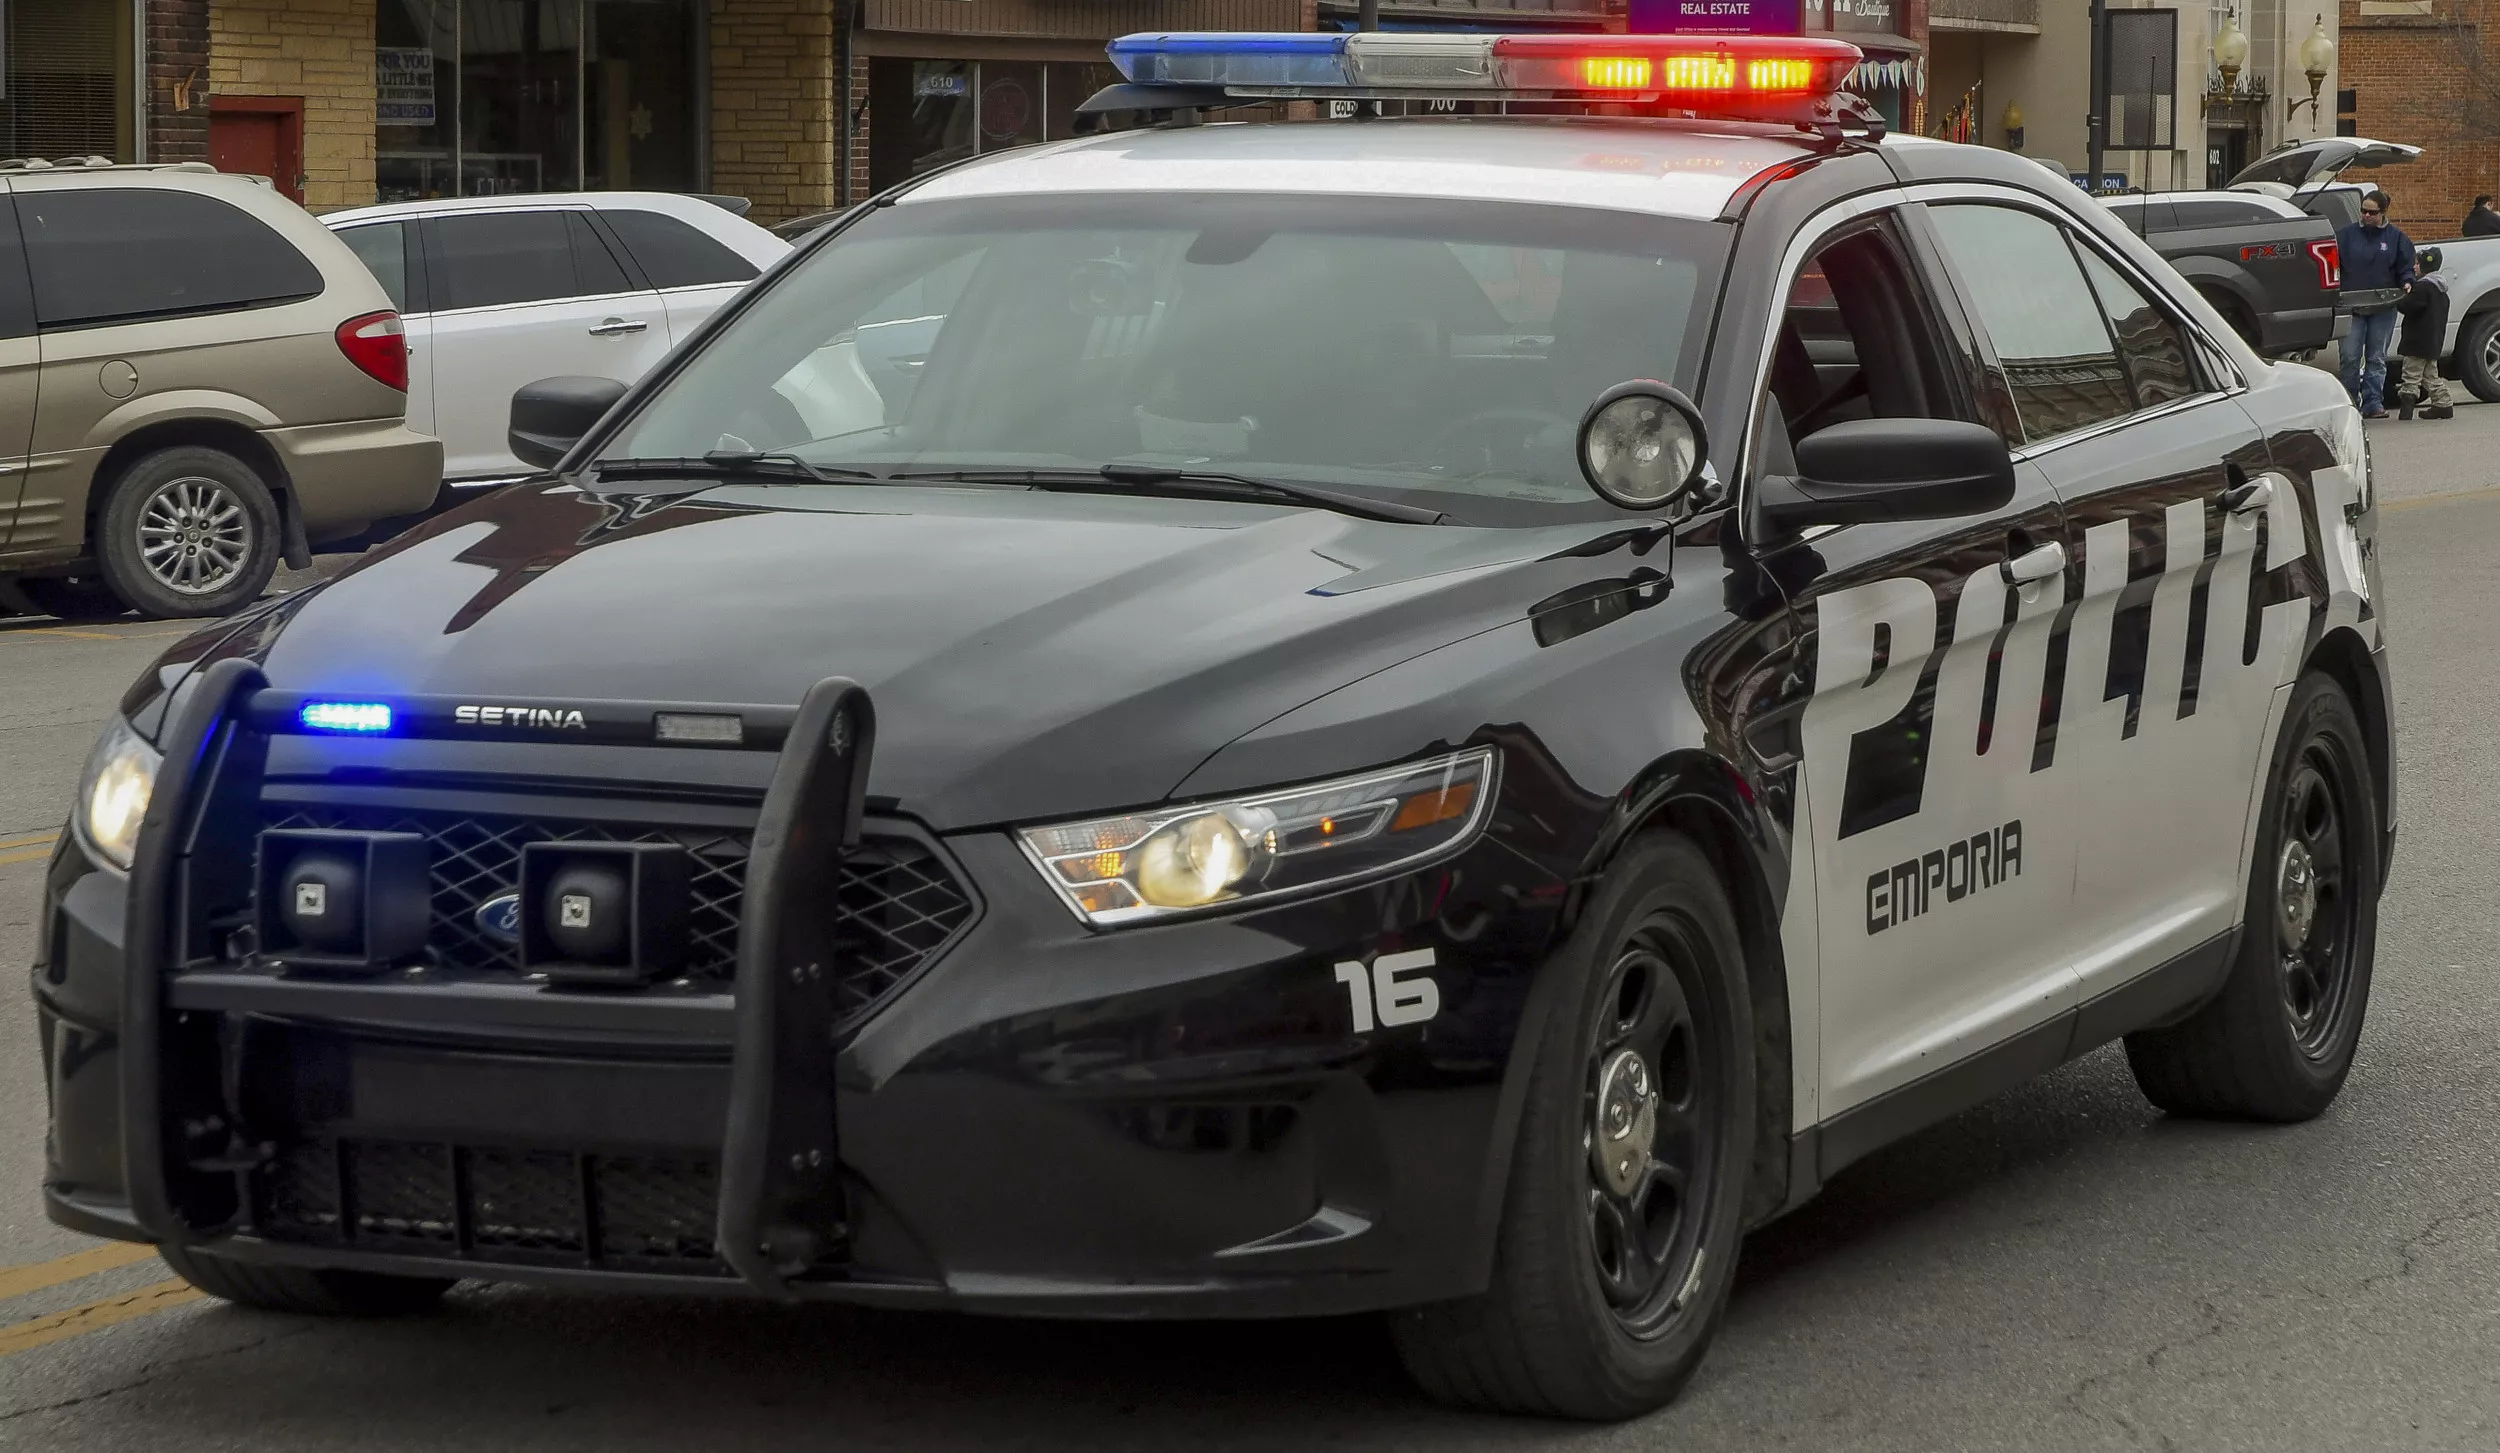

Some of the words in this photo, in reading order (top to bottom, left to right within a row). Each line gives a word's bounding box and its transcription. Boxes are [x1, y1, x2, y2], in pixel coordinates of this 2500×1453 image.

[1680, 3, 1707, 15] REAL
[1710, 3, 1750, 15] ESTATE
[403, 54, 430, 69] YOU
[931, 76, 953, 88] 610
[402, 106, 429, 117] USED
[1335, 101, 1355, 116] COLD
[2209, 150, 2220, 165] 602
[2073, 178, 2120, 189] CAION
[2240, 242, 2297, 261] FX4
[1805, 464, 2376, 840] POLICE
[455, 705, 587, 729] SETINA
[1866, 819, 2022, 936] EMPORIA
[1334, 947, 1440, 1033] 16
